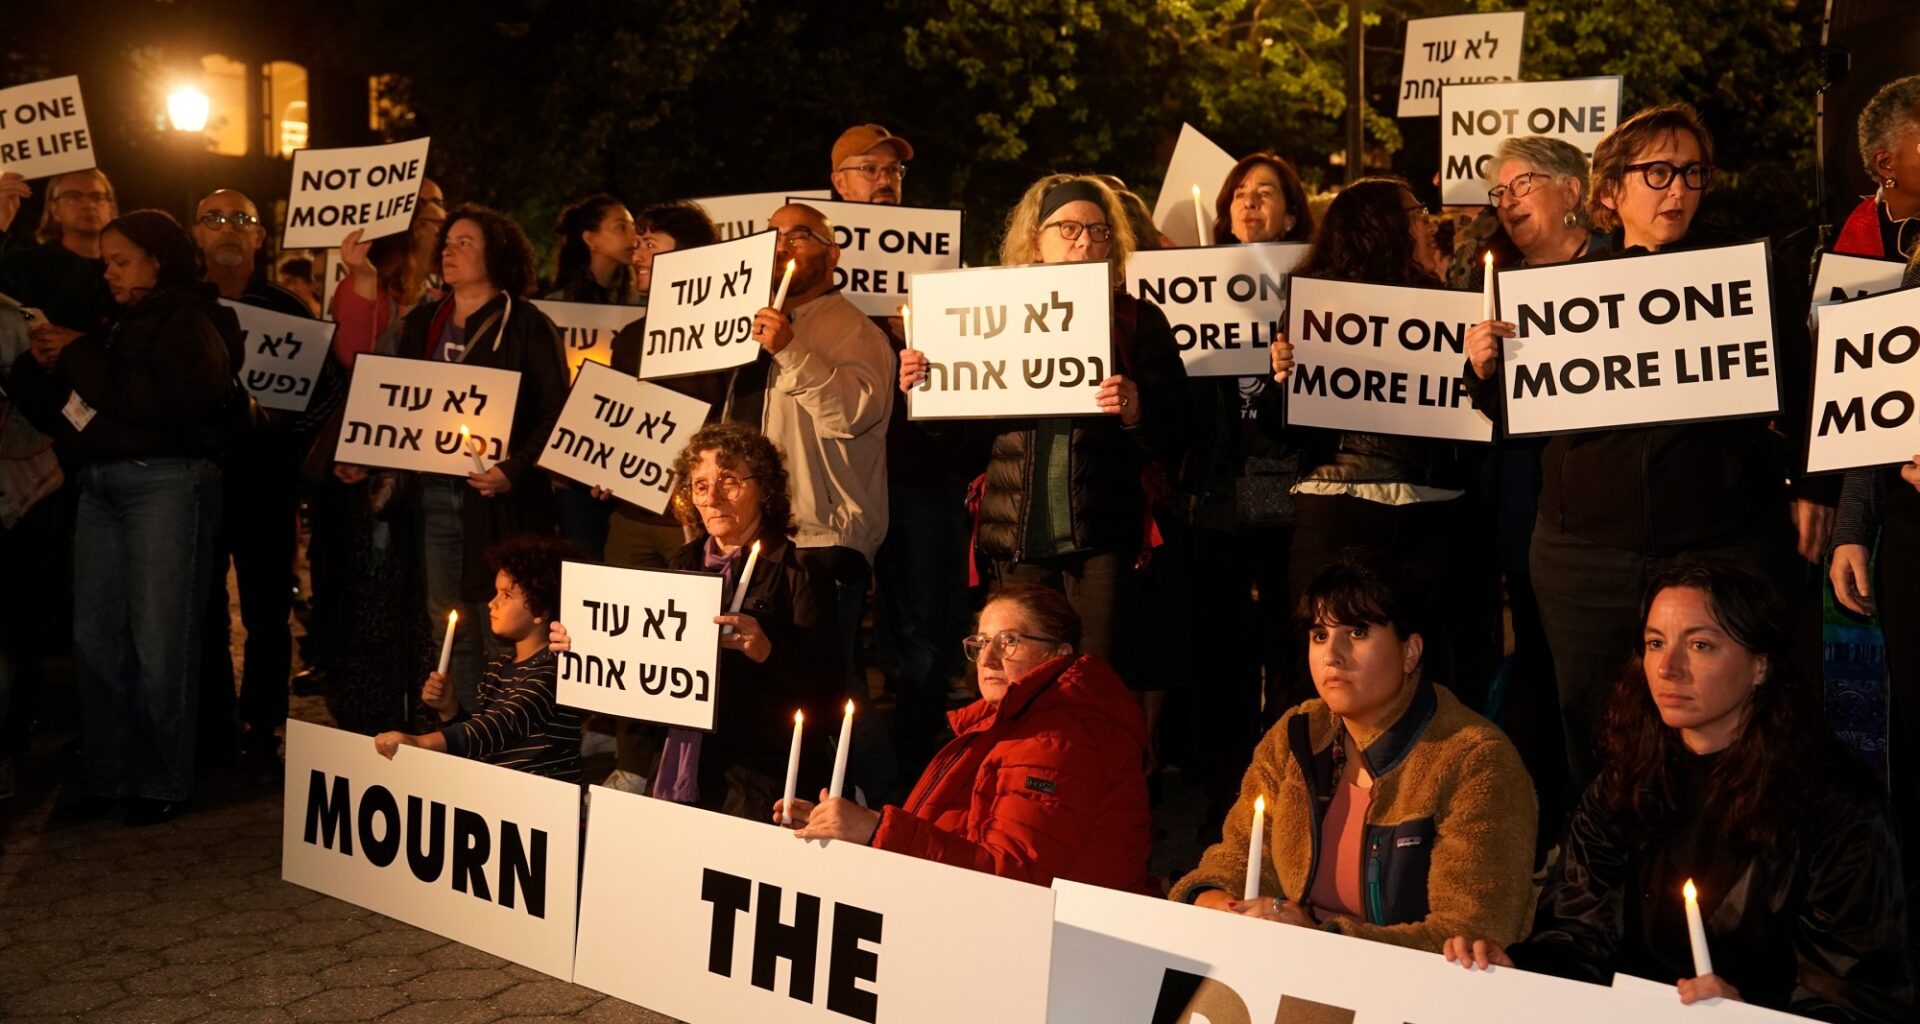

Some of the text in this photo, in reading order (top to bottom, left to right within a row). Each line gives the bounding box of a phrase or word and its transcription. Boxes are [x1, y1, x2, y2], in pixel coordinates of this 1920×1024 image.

[1422, 30, 1499, 64] לא עוד
[14, 96, 76, 125] ONE
[1451, 106, 1606, 136] NOT ONE
[0, 129, 89, 164] RE LIFE
[301, 159, 419, 192] NOT ONE
[290, 193, 416, 228] MORE LIFE
[833, 225, 950, 256] OT ONE
[671, 259, 753, 307] לא עוד
[832, 266, 888, 294] ORE
[1139, 272, 1288, 305] NOT ON
[945, 291, 1074, 340] לא עוד
[1517, 279, 1754, 339] NOT ONE
[257, 331, 303, 360] לא
[646, 323, 705, 356] אחת
[714, 315, 751, 347] פש
[1171, 322, 1242, 351] ORE
[1302, 309, 1479, 355] NOT ON
[1834, 325, 1920, 374] NO
[247, 369, 312, 397] נפש
[918, 355, 1105, 392] נפש אחת
[1292, 363, 1481, 410] MORE LIF
[1513, 340, 1770, 399] MORE LIFE
[379, 383, 488, 416] לא עוד
[344, 420, 423, 451] אחת
[593, 393, 677, 445] לא עוד
[550, 426, 679, 494] נפש אחת
[582, 598, 688, 642] לא עוד
[561, 651, 710, 702] נפש אחת
[304, 769, 548, 920] MOURN
[701, 867, 884, 1024] THE
